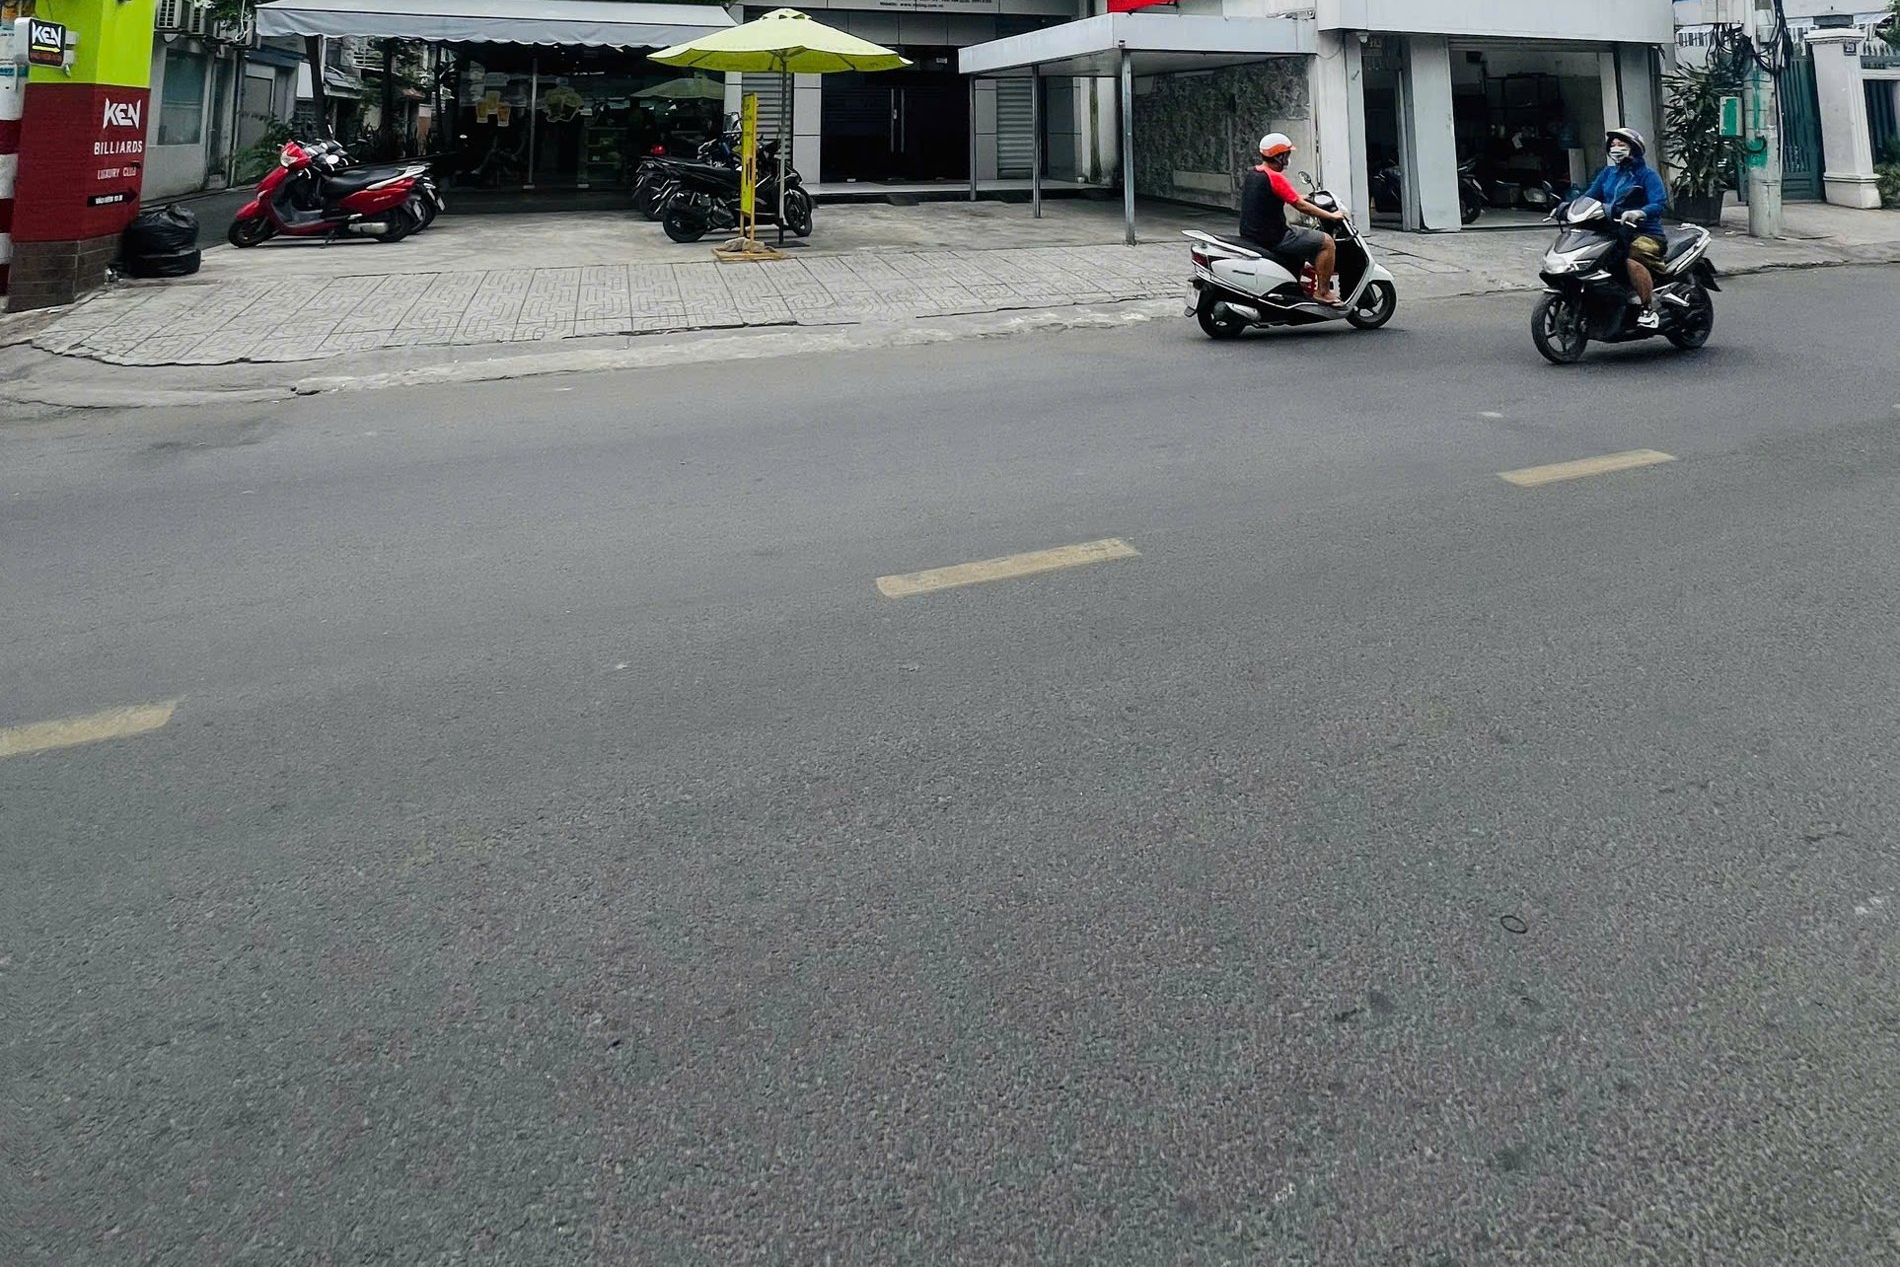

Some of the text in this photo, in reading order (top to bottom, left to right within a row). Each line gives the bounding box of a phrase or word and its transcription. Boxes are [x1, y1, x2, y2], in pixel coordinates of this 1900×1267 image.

[32, 21, 62, 48] KEN
[103, 98, 141, 129] KEN
[94, 140, 143, 155] BILLIARDS
